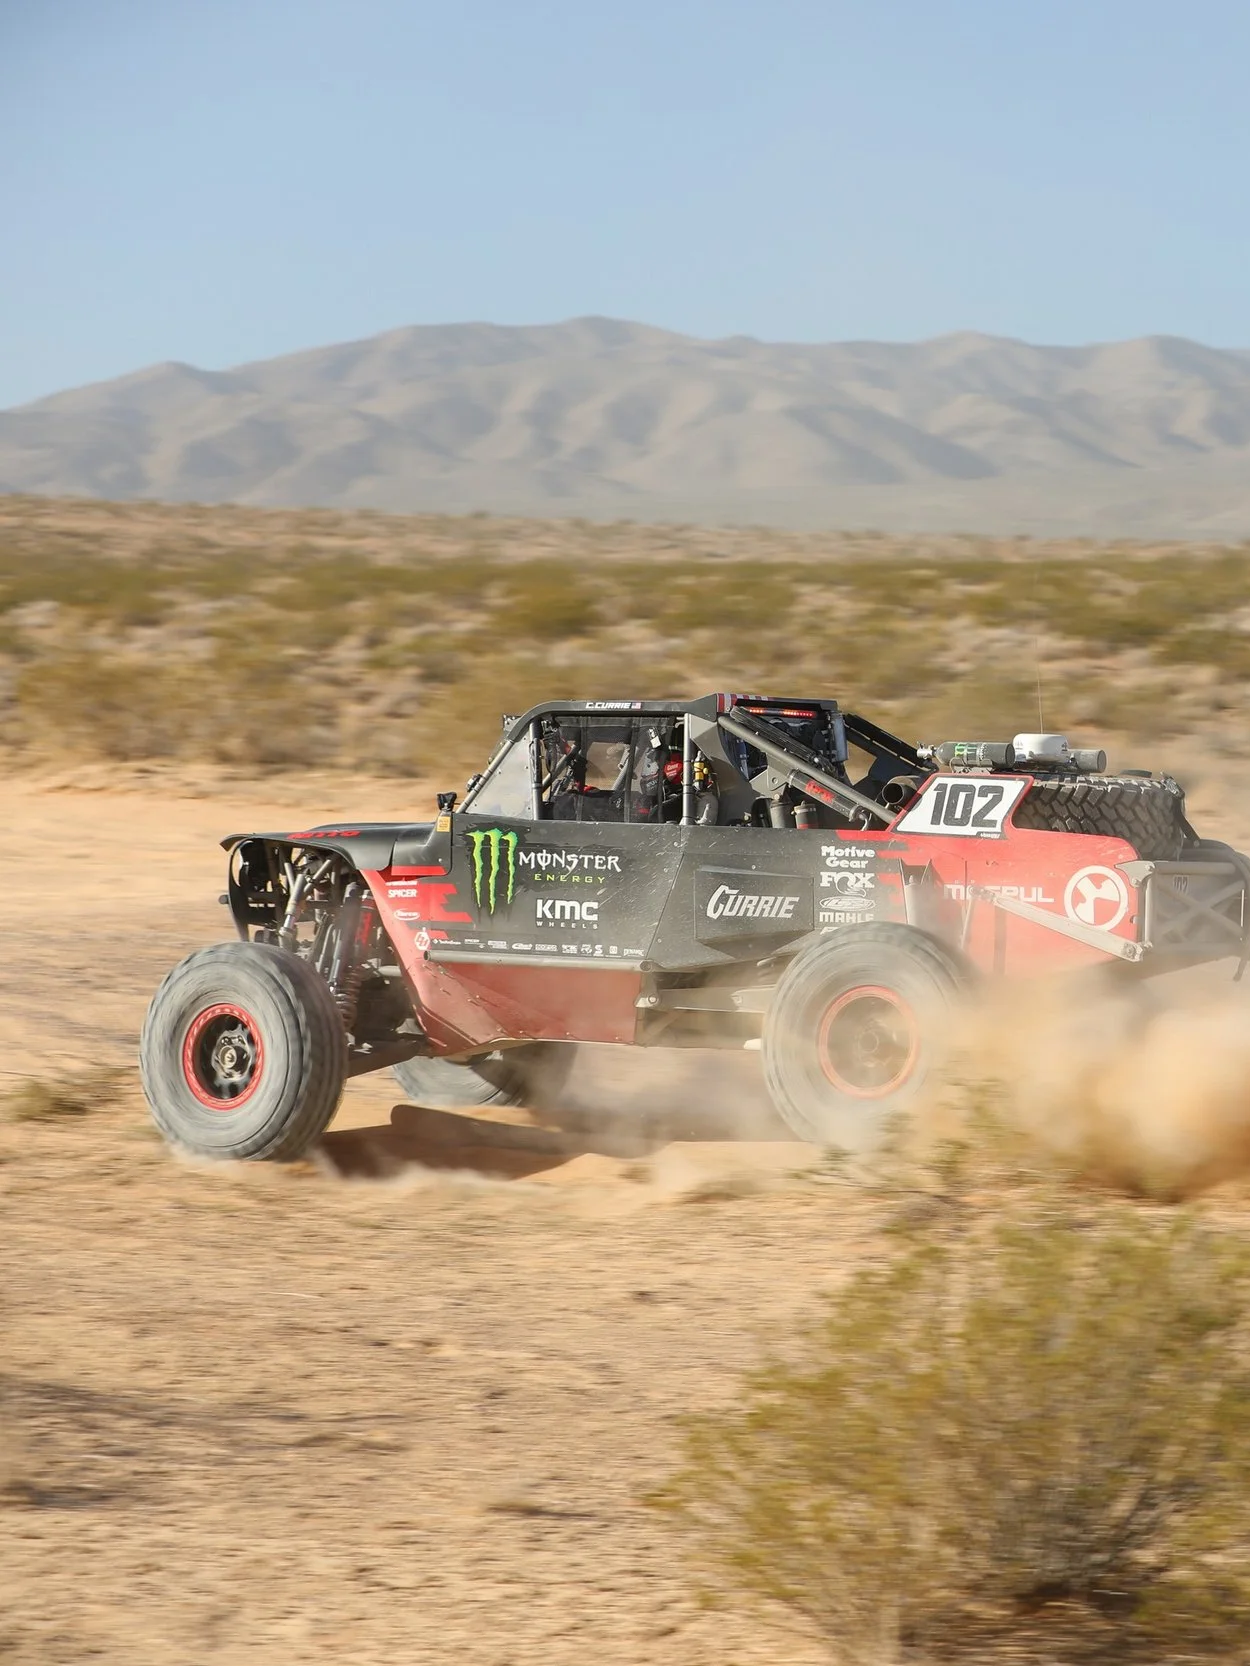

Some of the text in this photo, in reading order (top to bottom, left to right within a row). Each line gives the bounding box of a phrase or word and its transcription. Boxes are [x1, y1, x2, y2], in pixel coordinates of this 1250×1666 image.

[930, 782, 1005, 828] 102
[821, 845, 876, 858] Motive
[518, 849, 622, 873] MONSTER
[825, 856, 869, 869] Gear
[534, 873, 605, 884] ENERGY
[820, 871, 875, 896] FOX
[536, 899, 599, 921] KMC
[706, 884, 800, 920] CURRIE
[536, 921, 598, 930] WHEELS
[819, 911, 875, 923] MAHLE
